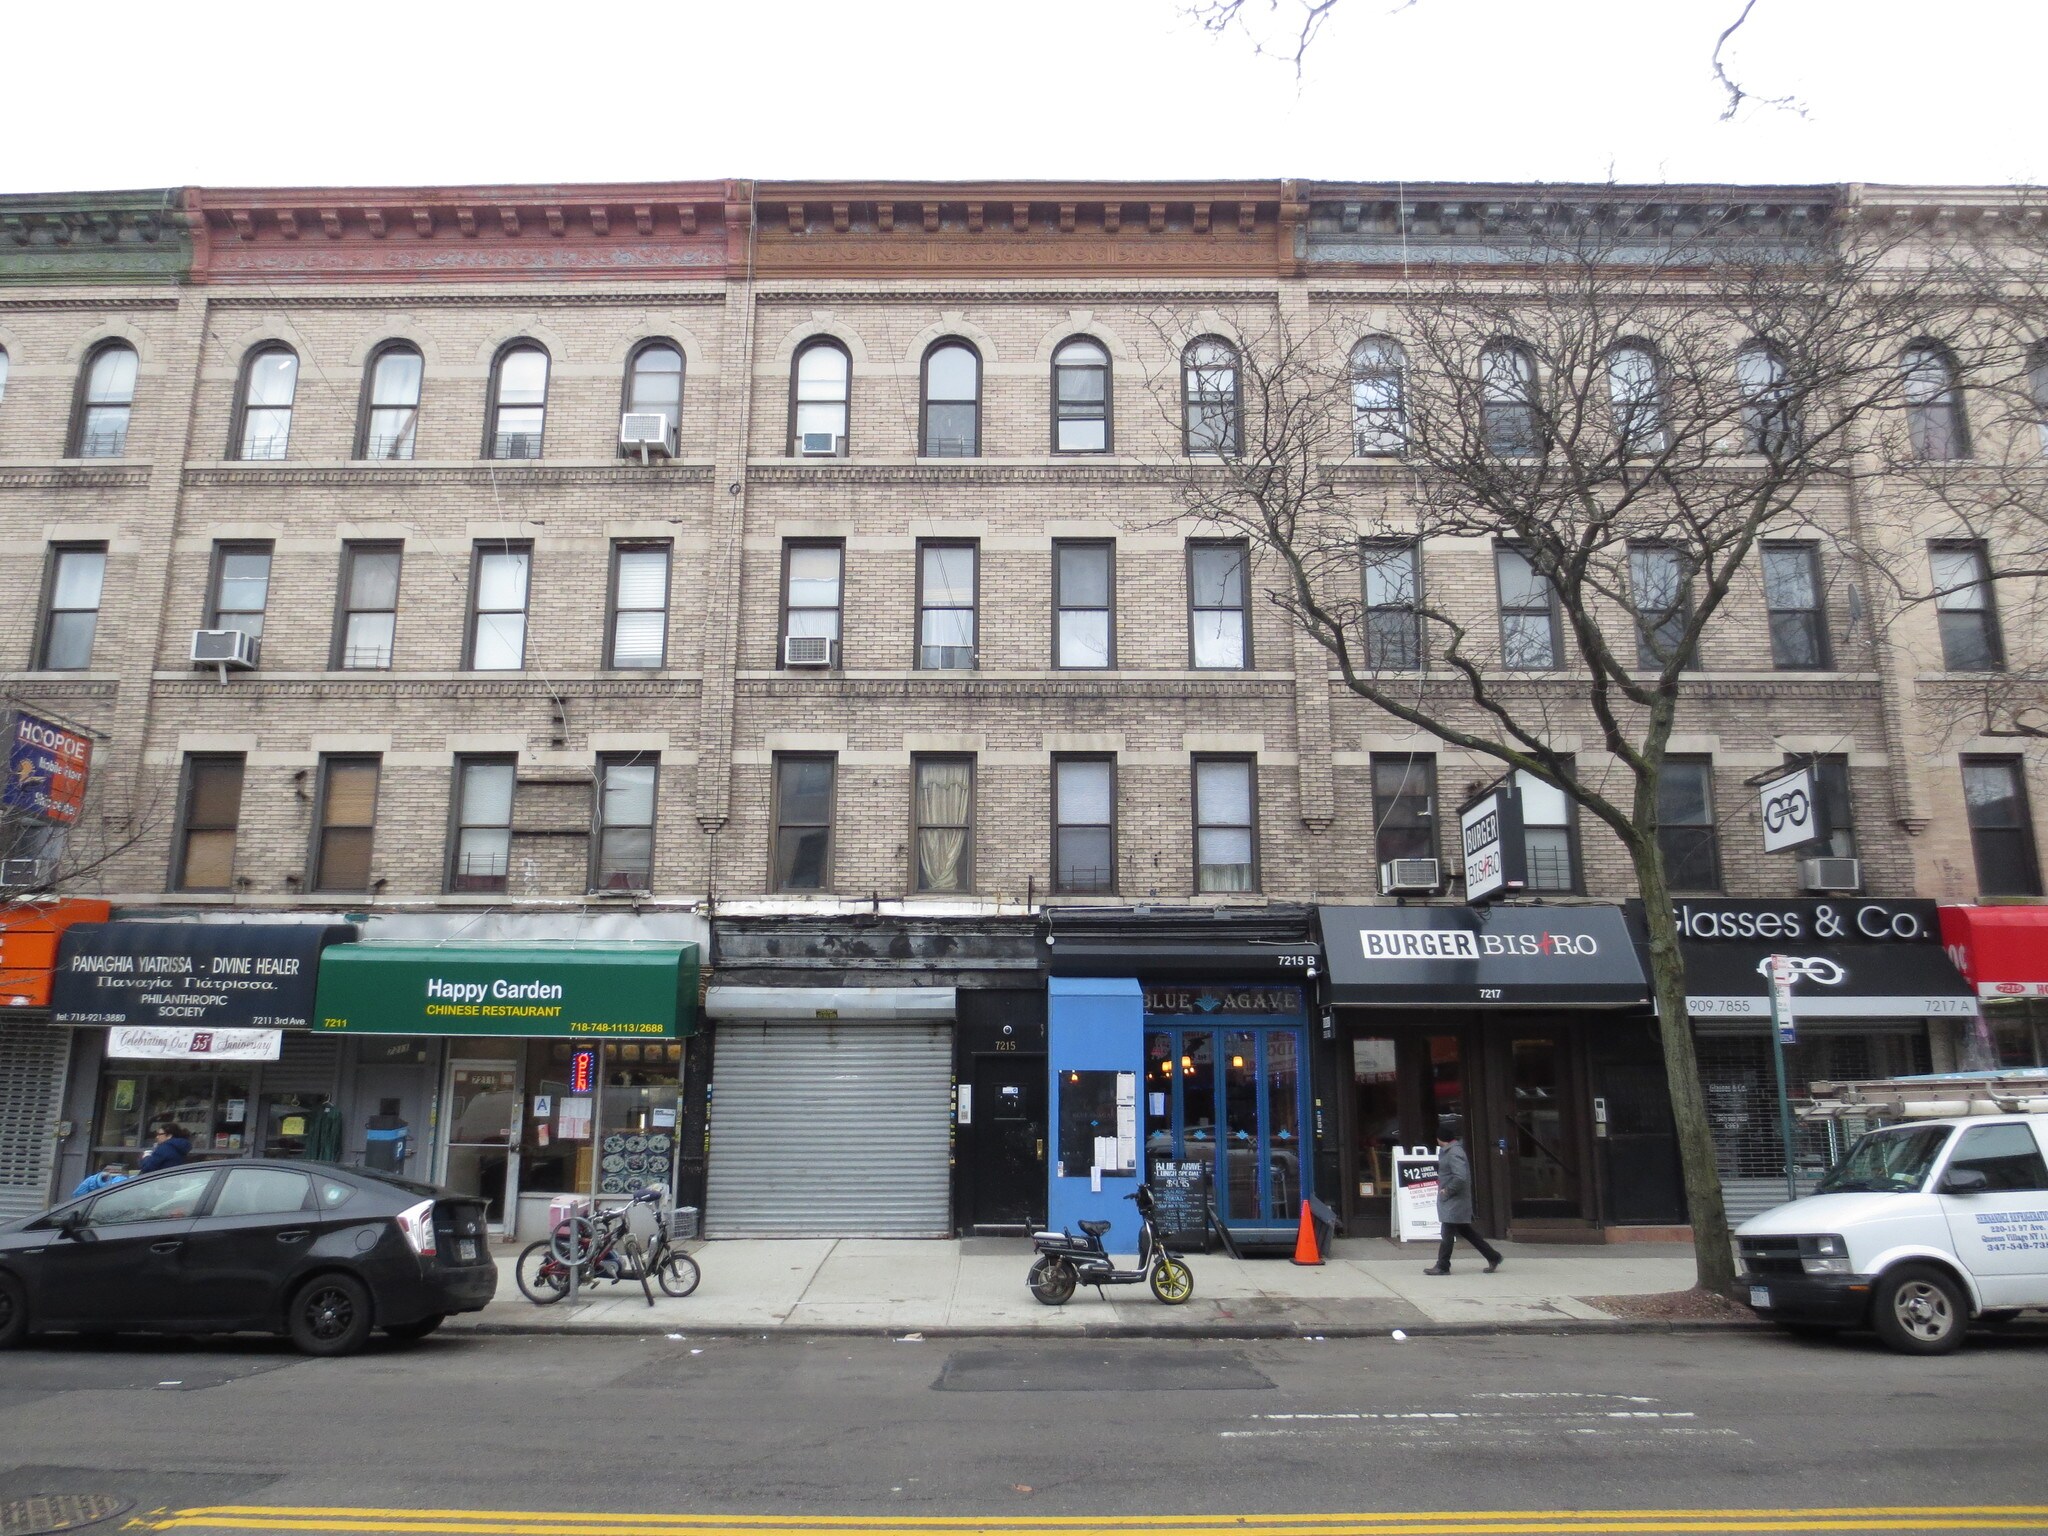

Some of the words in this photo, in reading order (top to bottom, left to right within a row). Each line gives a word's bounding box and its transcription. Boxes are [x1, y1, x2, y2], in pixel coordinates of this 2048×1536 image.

[20, 720, 86, 759] HOOPOE
[1466, 814, 1497, 853] BURGER
[1815, 905, 1845, 938] &
[1857, 905, 1929, 938] Co.
[1366, 933, 1473, 956] BURGER
[72, 956, 134, 973] PANAGHIA
[139, 956, 193, 973] YIATRISSA
[212, 957, 252, 974] DIVINE
[256, 958, 300, 976] HEALER
[1278, 956, 1304, 966] 7215
[1307, 956, 1316, 966] B
[428, 979, 489, 1002] Happy
[492, 979, 563, 1000] Garden
[1480, 989, 1501, 999] 7217
[141, 994, 229, 1006] PHILANTHROPIC
[1143, 993, 1191, 1009] BLUE
[1223, 993, 1296, 1009] AGAVE
[1925, 1000, 1956, 1012] 7217
[1960, 1001, 1970, 1012] A
[158, 1006, 206, 1017] SOCIETY
[426, 1004, 480, 1016] CHINESE
[482, 1005, 562, 1017] RESTAURANT
[70, 1013, 126, 1022] 718-921-3880
[253, 1016, 273, 1025] 7211
[275, 1016, 289, 1025] 3rd
[289, 1017, 308, 1025] Ave.
[324, 1018, 348, 1028] 7211
[570, 1022, 663, 1033] 718-748-1113/2688
[120, 1031, 168, 1052] Celebrating
[171, 1036, 189, 1049] Our
[216, 1033, 272, 1055] Anniversary
[995, 1040, 1016, 1051] 7215
[577, 1053, 589, 1091] OPEN
[537, 1098, 548, 1111] A
[1155, 1162, 1177, 1171] BLUE
[1403, 1168, 1421, 1180] $12
